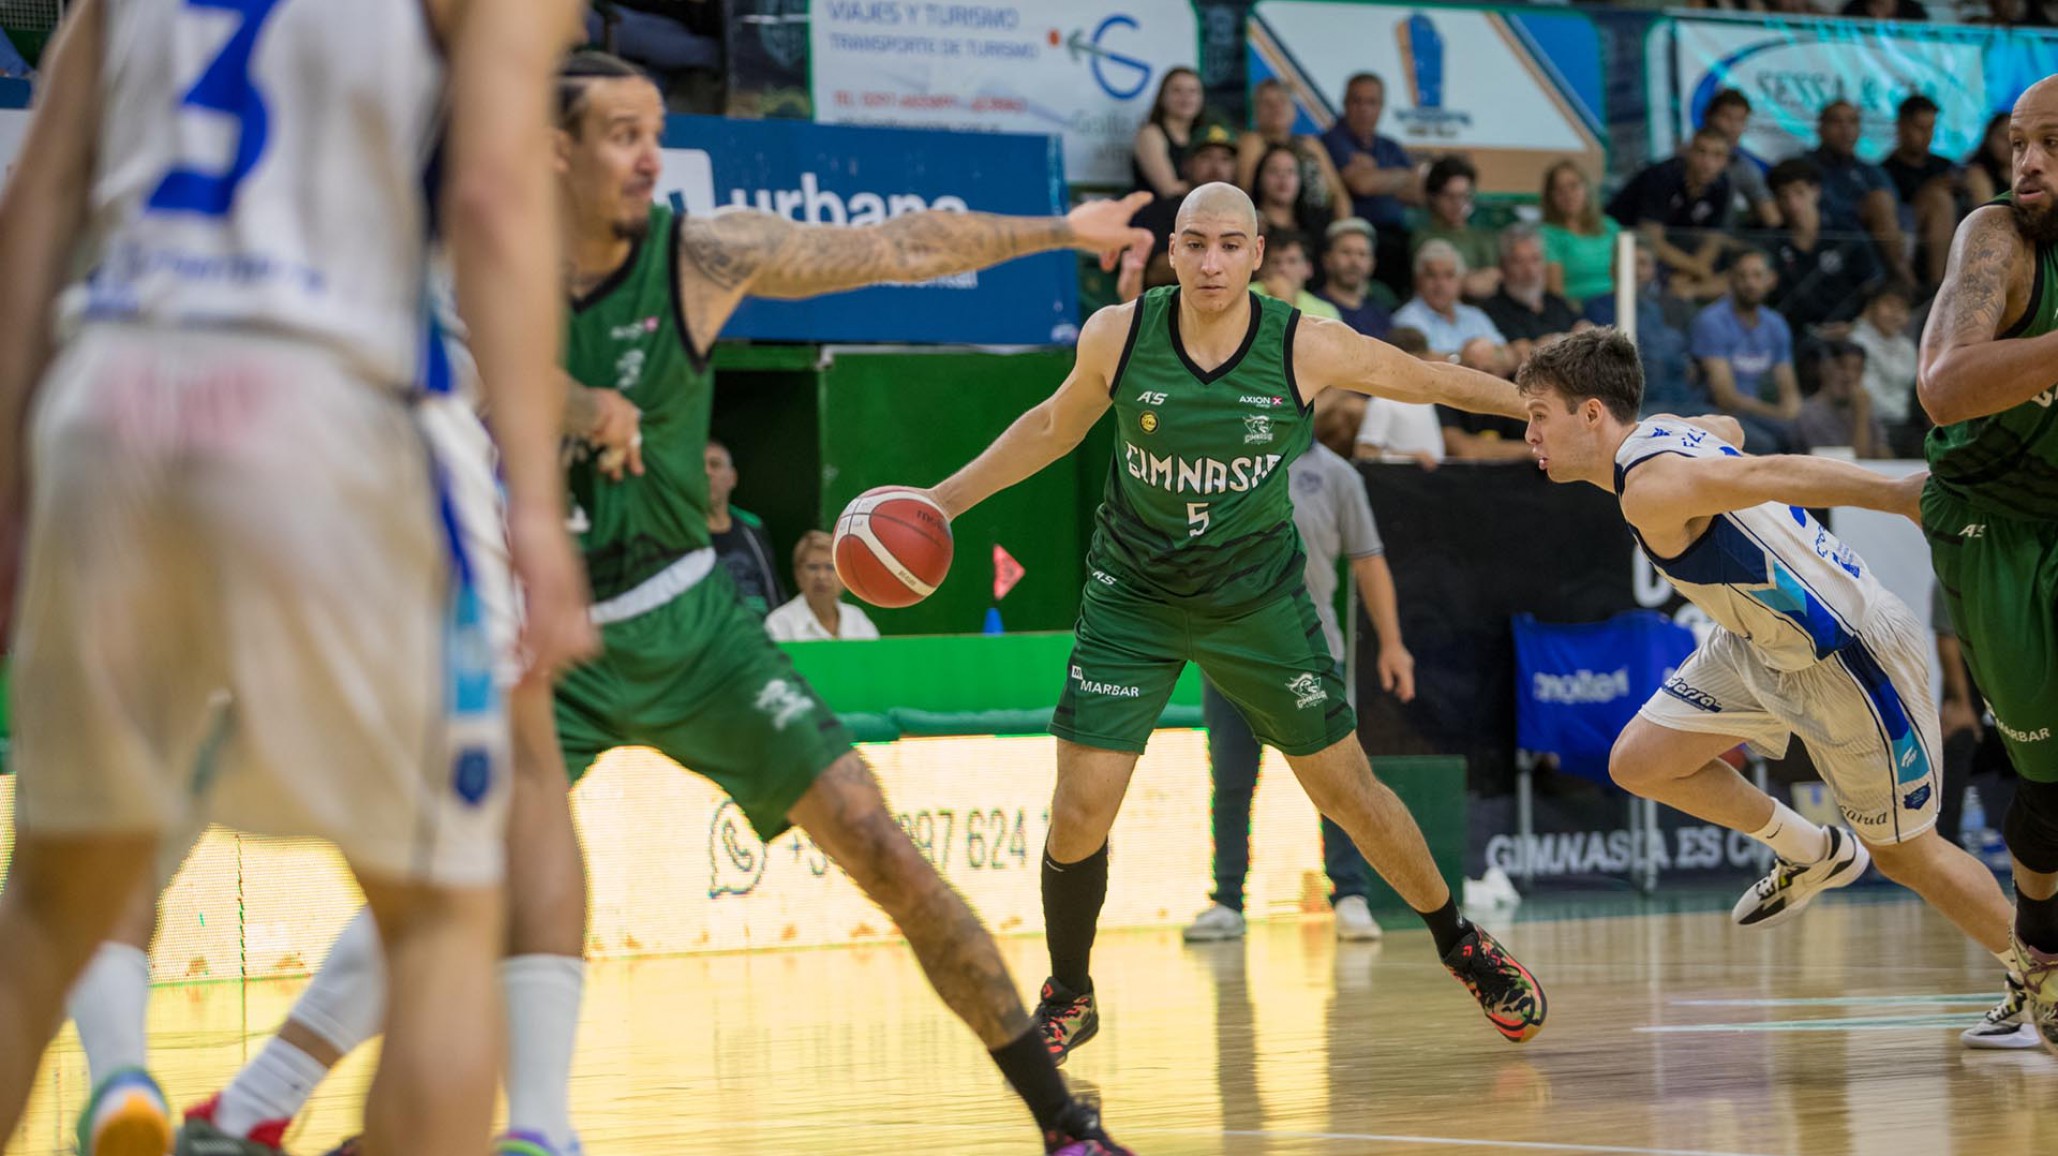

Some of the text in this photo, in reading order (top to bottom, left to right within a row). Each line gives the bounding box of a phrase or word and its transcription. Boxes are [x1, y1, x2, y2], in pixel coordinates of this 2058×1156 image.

[827, 1, 898, 24] VIAJES
[924, 4, 1020, 30] TURISMO
[830, 32, 936, 53] TRANSPORTE
[968, 40, 1040, 58] TURISMO
[144, 0, 271, 217] 3
[1239, 396, 1271, 405] AXION
[1186, 502, 1209, 537] 5
[1080, 680, 1139, 697] MARBAR
[966, 808, 1025, 868] 624
[1676, 825, 1723, 868] ES
